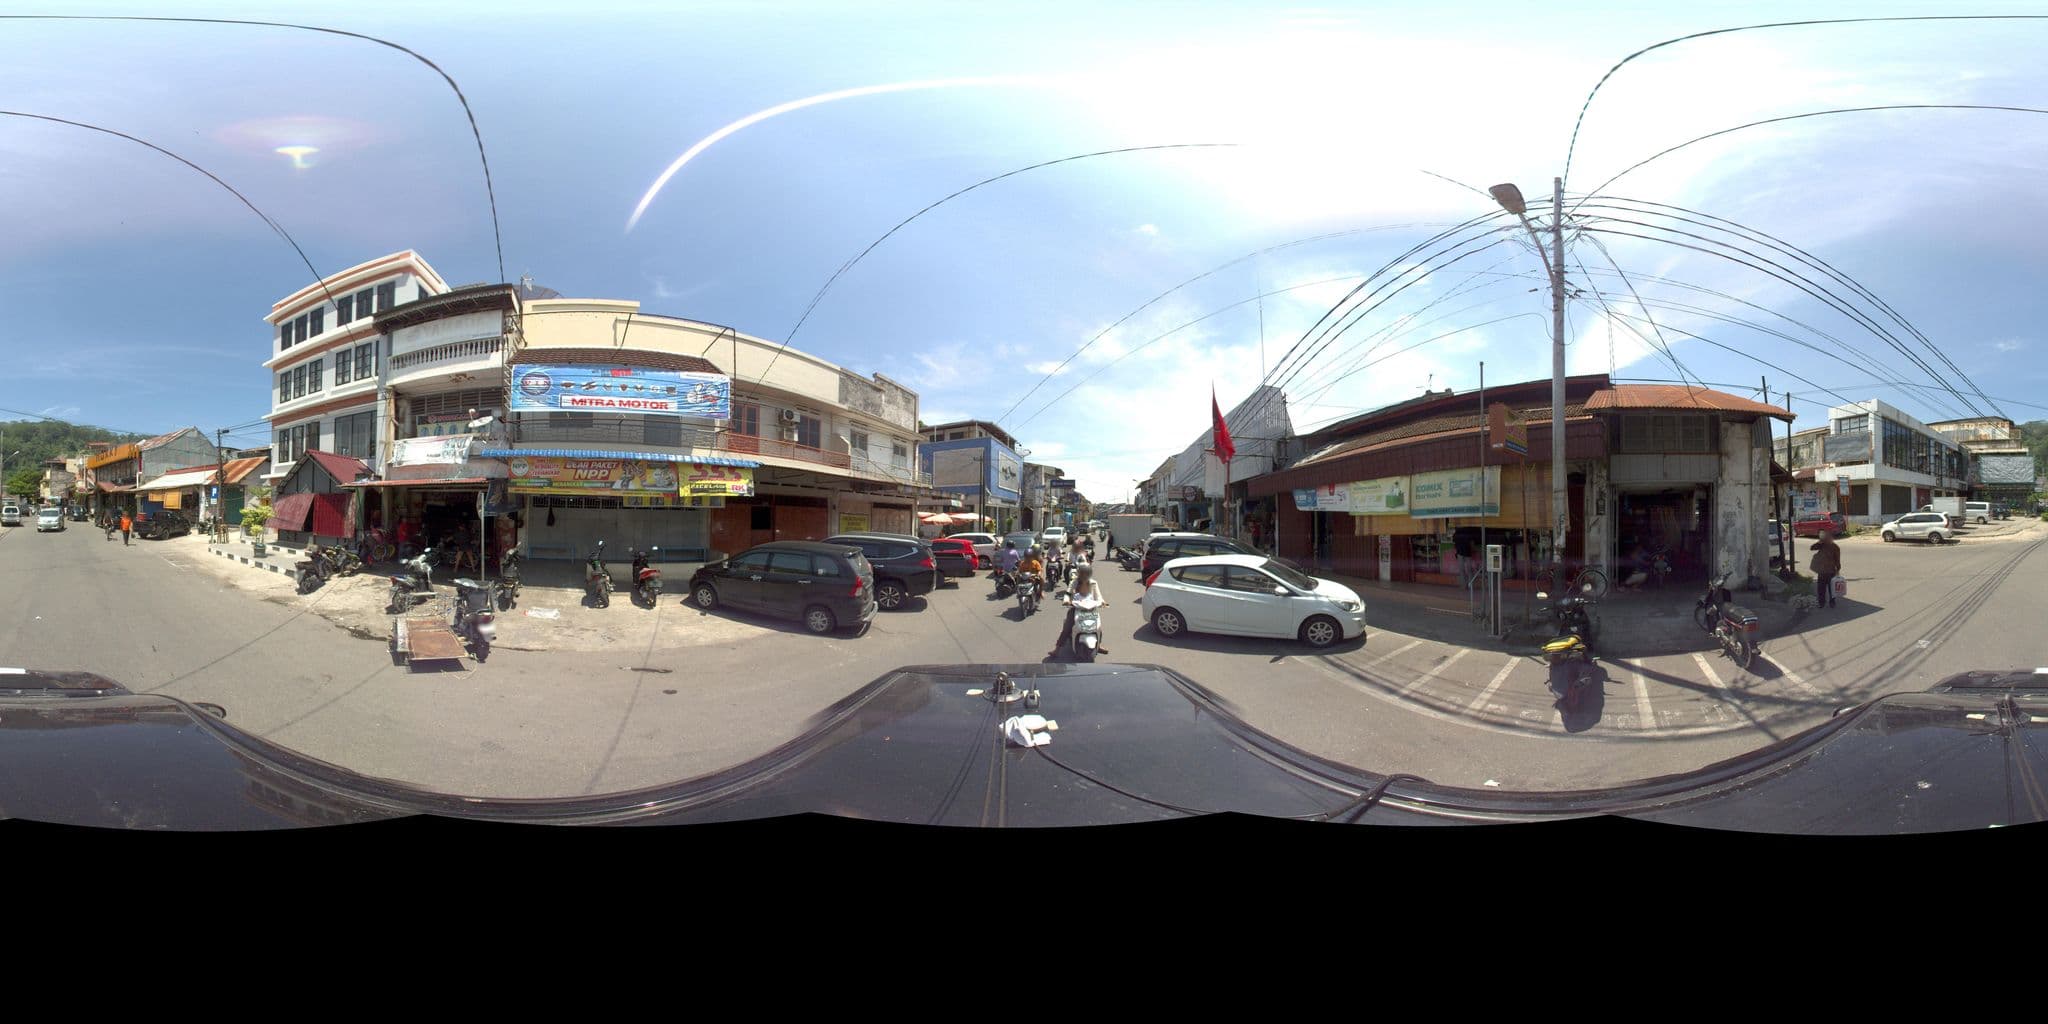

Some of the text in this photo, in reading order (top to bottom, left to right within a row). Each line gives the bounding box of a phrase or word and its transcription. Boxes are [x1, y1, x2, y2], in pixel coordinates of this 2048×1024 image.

[571, 398, 668, 410] MITRA MOTOR
[574, 469, 609, 479] NPP
[212, 488, 217, 497] P
